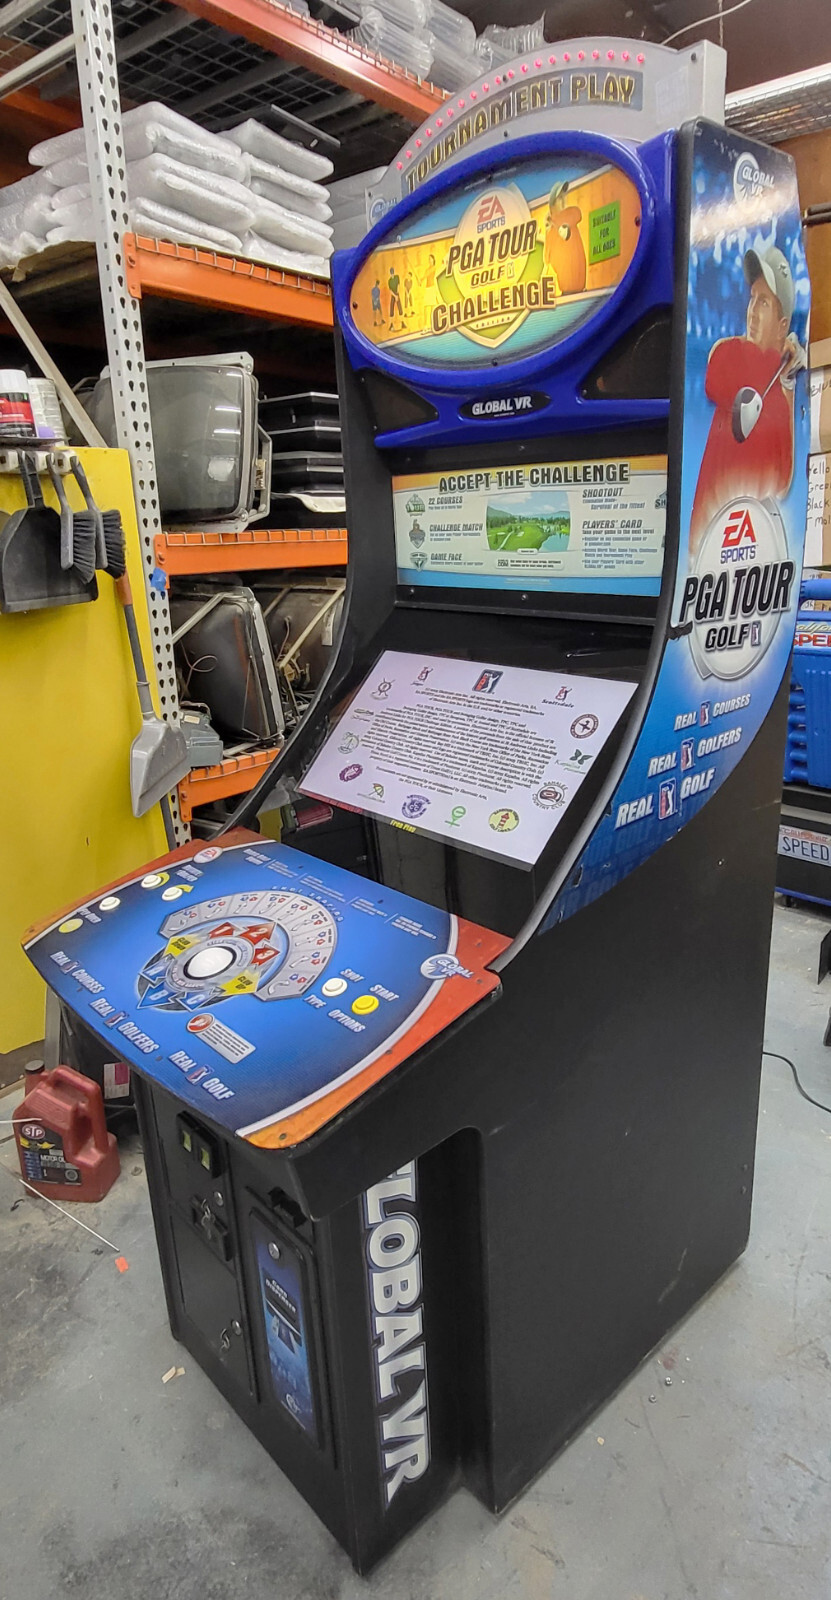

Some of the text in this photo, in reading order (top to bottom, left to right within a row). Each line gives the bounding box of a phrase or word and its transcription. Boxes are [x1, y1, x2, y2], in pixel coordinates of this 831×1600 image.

[404, 71, 635, 190] TOURNAMENT PLAY
[742, 165, 775, 188] GLOBAL
[751, 184, 763, 197] VR
[477, 195, 505, 223] EA
[477, 215, 506, 234] SPORTS
[446, 219, 537, 275] PGA TOUR
[471, 264, 506, 287] GOLF
[433, 277, 556, 331] CHALLENGE
[472, 395, 533, 416] GLOBAL VR
[438, 462, 630, 494] ACCEPT THE CHALLENGE
[436, 496, 463, 505] COURSES
[582, 487, 624, 498] SHOOTOUT
[429, 522, 483, 532] CHALLENGE MATCH
[620, 519, 643, 529] CARD
[722, 509, 757, 546] EA
[720, 544, 757, 565] SPORTS
[678, 560, 795, 624] PGA TOUR
[705, 623, 750, 650] GOLF
[541, 698, 575, 708] Scottsdale
[674, 693, 751, 731] REAL COURSES
[648, 727, 742, 778] REAL GOLFERS
[615, 768, 716, 830] REAL GOLF
[782, 836, 829, 861] SPEED
[250, 928, 268, 938] 2
[257, 947, 272, 959] 3
[50, 951, 105, 995] REAL COURSES
[339, 968, 366, 983] SHOT
[436, 958, 475, 979] GLOBAL
[441, 967, 456, 977] VR
[150, 989, 166, 1001] B
[187, 993, 206, 1005] C
[303, 994, 327, 1009] TYPE
[369, 984, 400, 1003] START
[89, 997, 160, 1054] REAL GOLFERS
[327, 1008, 367, 1034] OPTIONS
[168, 1050, 236, 1101] REAL GOLF
[24, 1126, 43, 1137] STP
[40, 1155, 58, 1163] MOTOR
[265, 1278, 297, 1314] DISPENSER
[271, 1278, 288, 1299] CARD
[383, 1388, 430, 1506] VR
